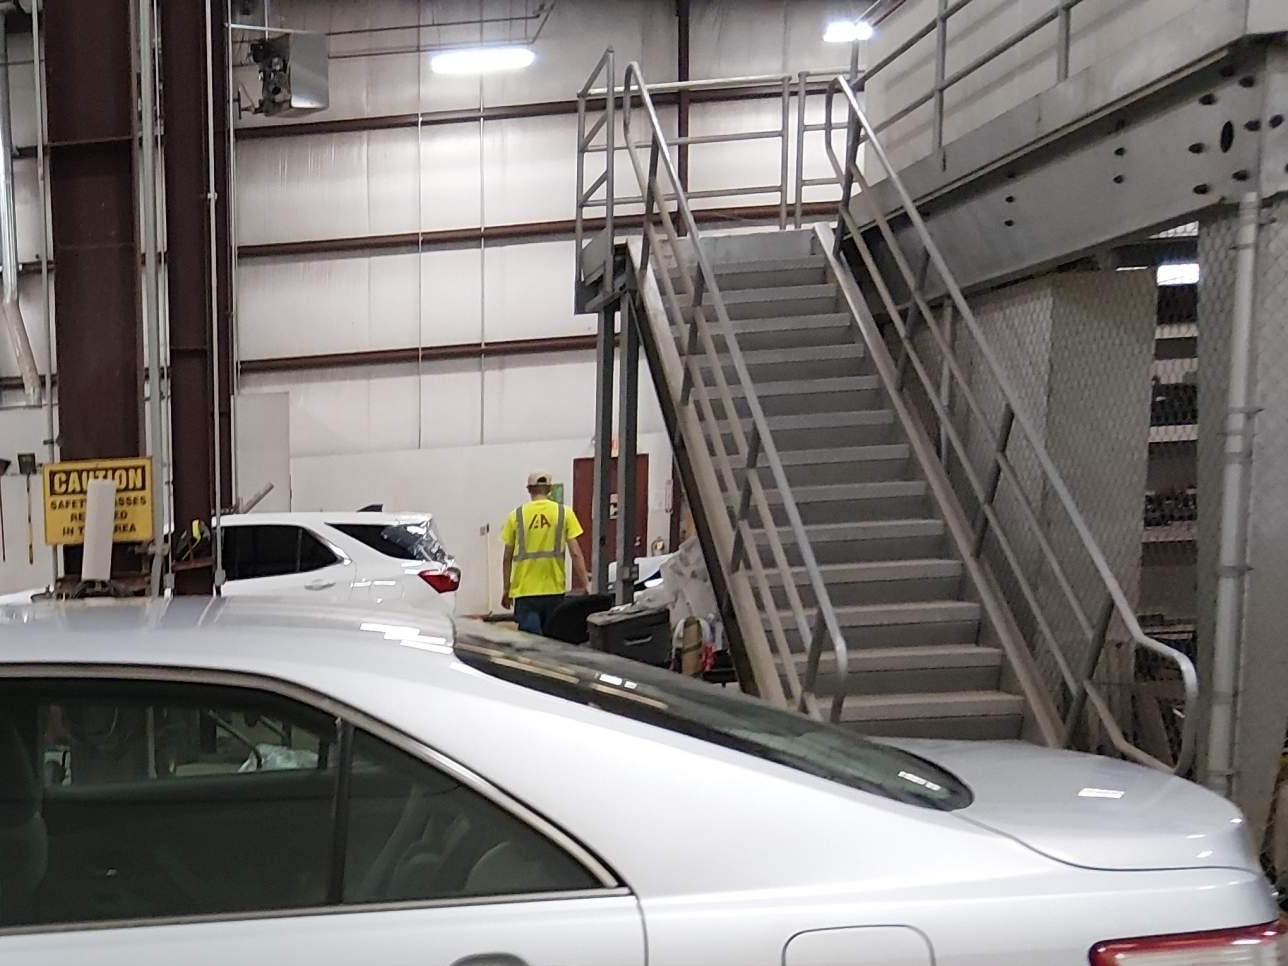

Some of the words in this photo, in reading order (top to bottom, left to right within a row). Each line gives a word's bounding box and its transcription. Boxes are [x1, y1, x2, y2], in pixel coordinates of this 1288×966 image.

[50, 498, 87, 510] SAFET
[114, 496, 147, 506] SSES
[62, 526, 74, 537] IN
[114, 522, 137, 534] REA
